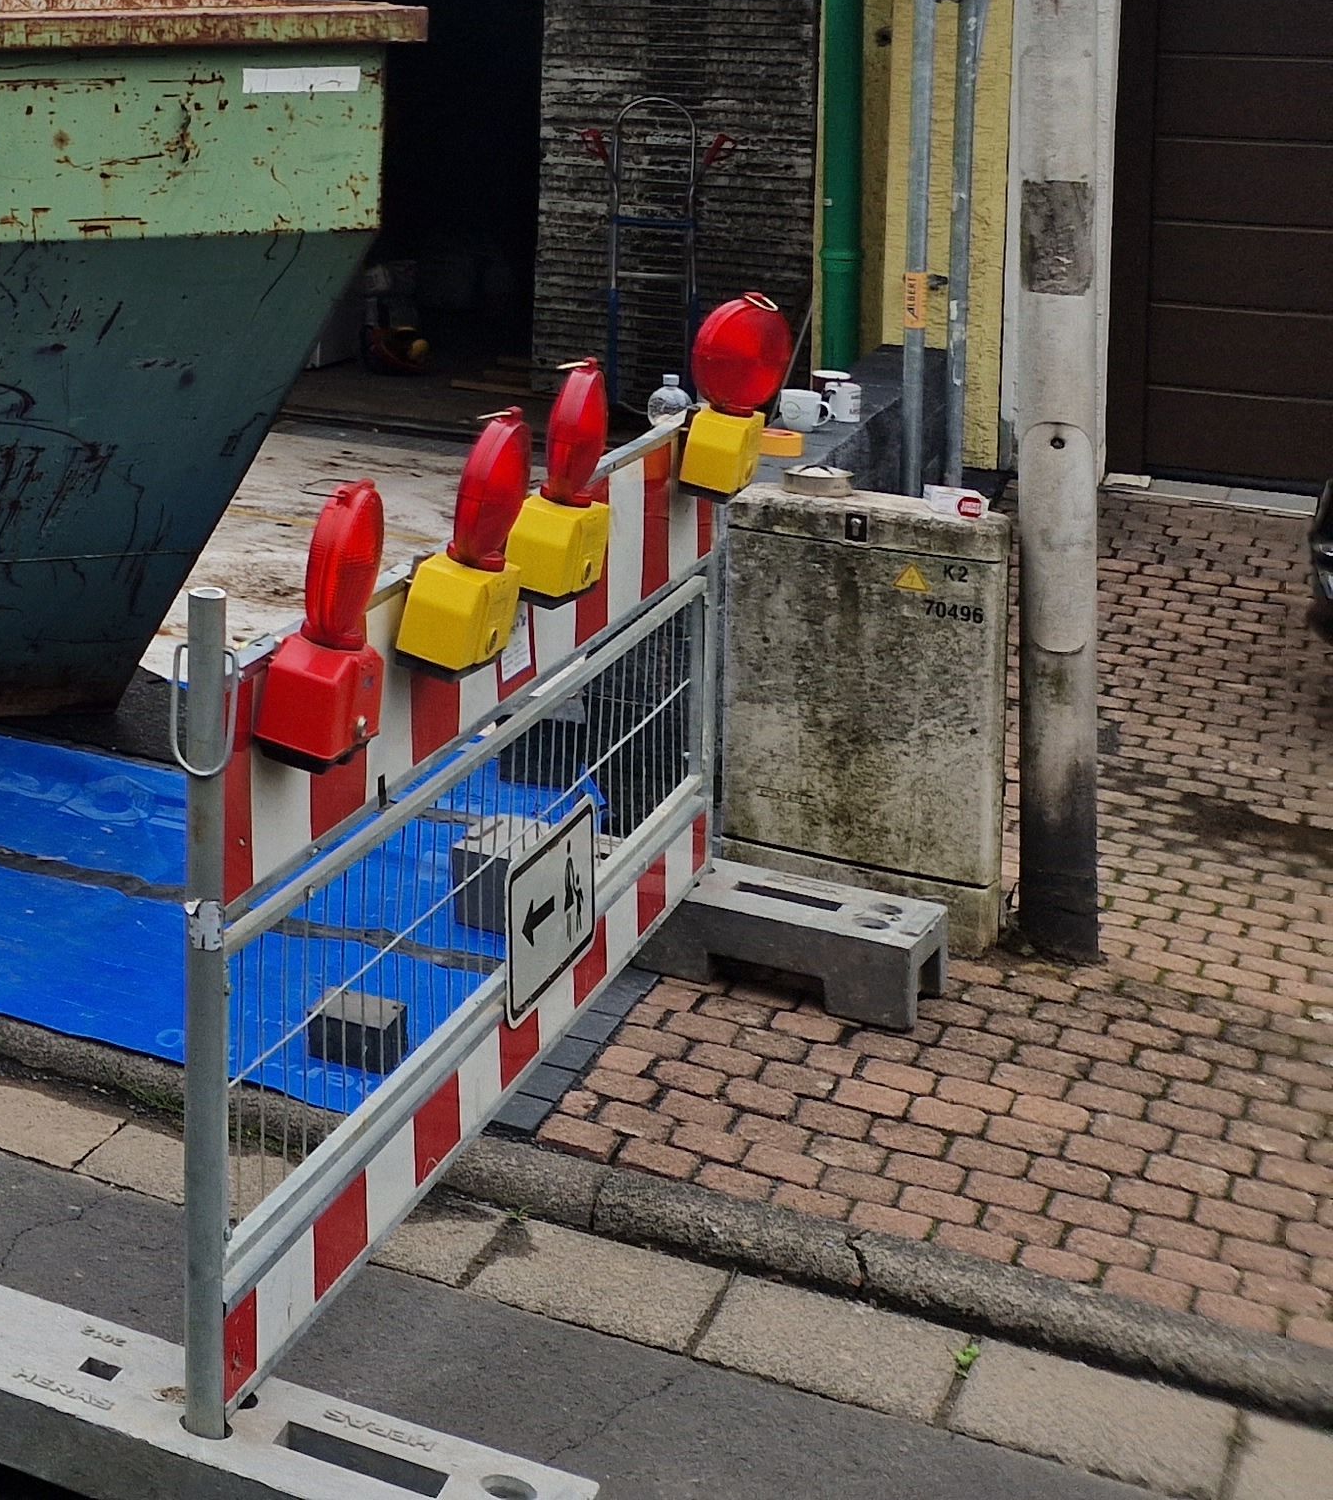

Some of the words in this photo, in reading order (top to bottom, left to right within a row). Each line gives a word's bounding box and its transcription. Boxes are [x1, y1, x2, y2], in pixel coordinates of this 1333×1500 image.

[907, 277, 919, 320] ALBERT
[943, 565, 968, 583] K2
[924, 600, 984, 624] 70496
[12, 1368, 116, 1411] HERAS
[323, 1409, 440, 1453] HERAS
